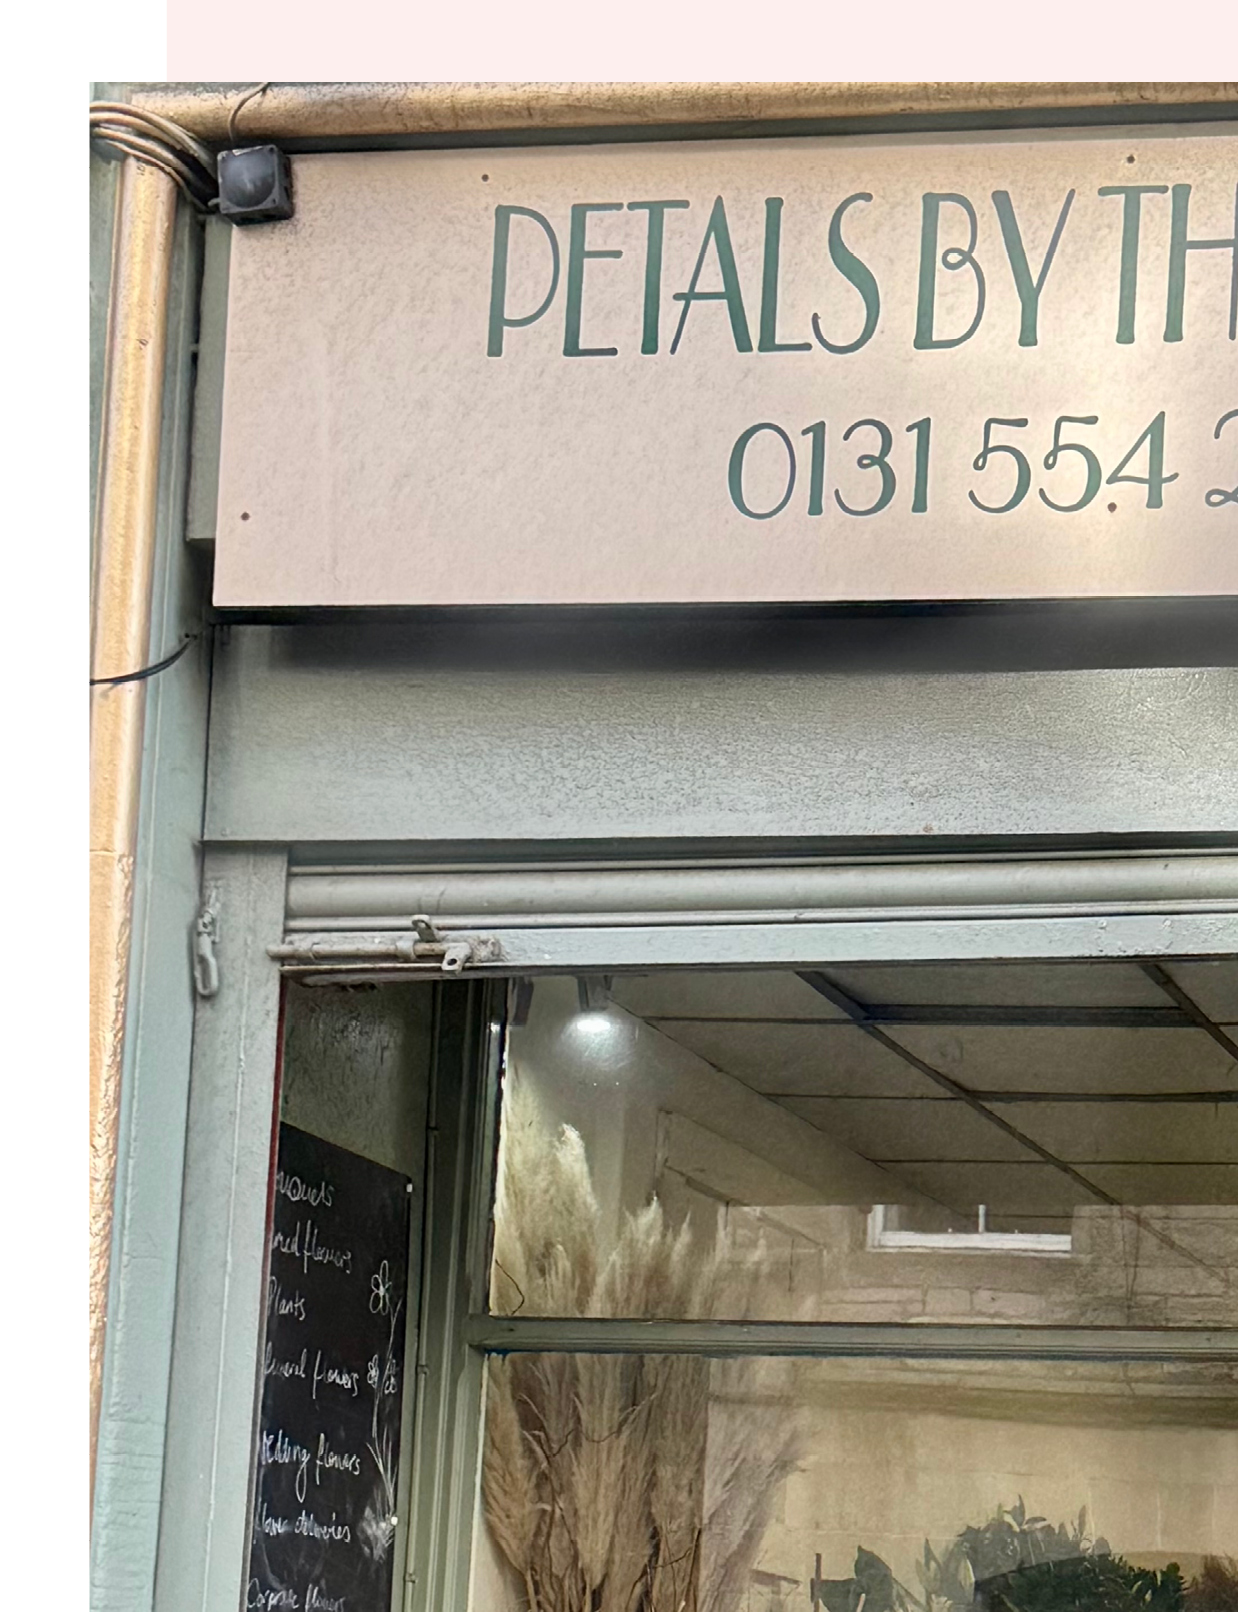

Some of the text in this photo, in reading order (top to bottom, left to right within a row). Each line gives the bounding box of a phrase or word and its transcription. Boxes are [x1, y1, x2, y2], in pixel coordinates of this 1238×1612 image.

[487, 192, 883, 358] PETALS
[913, 187, 1077, 352] BY
[727, 414, 934, 520] 0131
[966, 410, 1179, 514] 554
